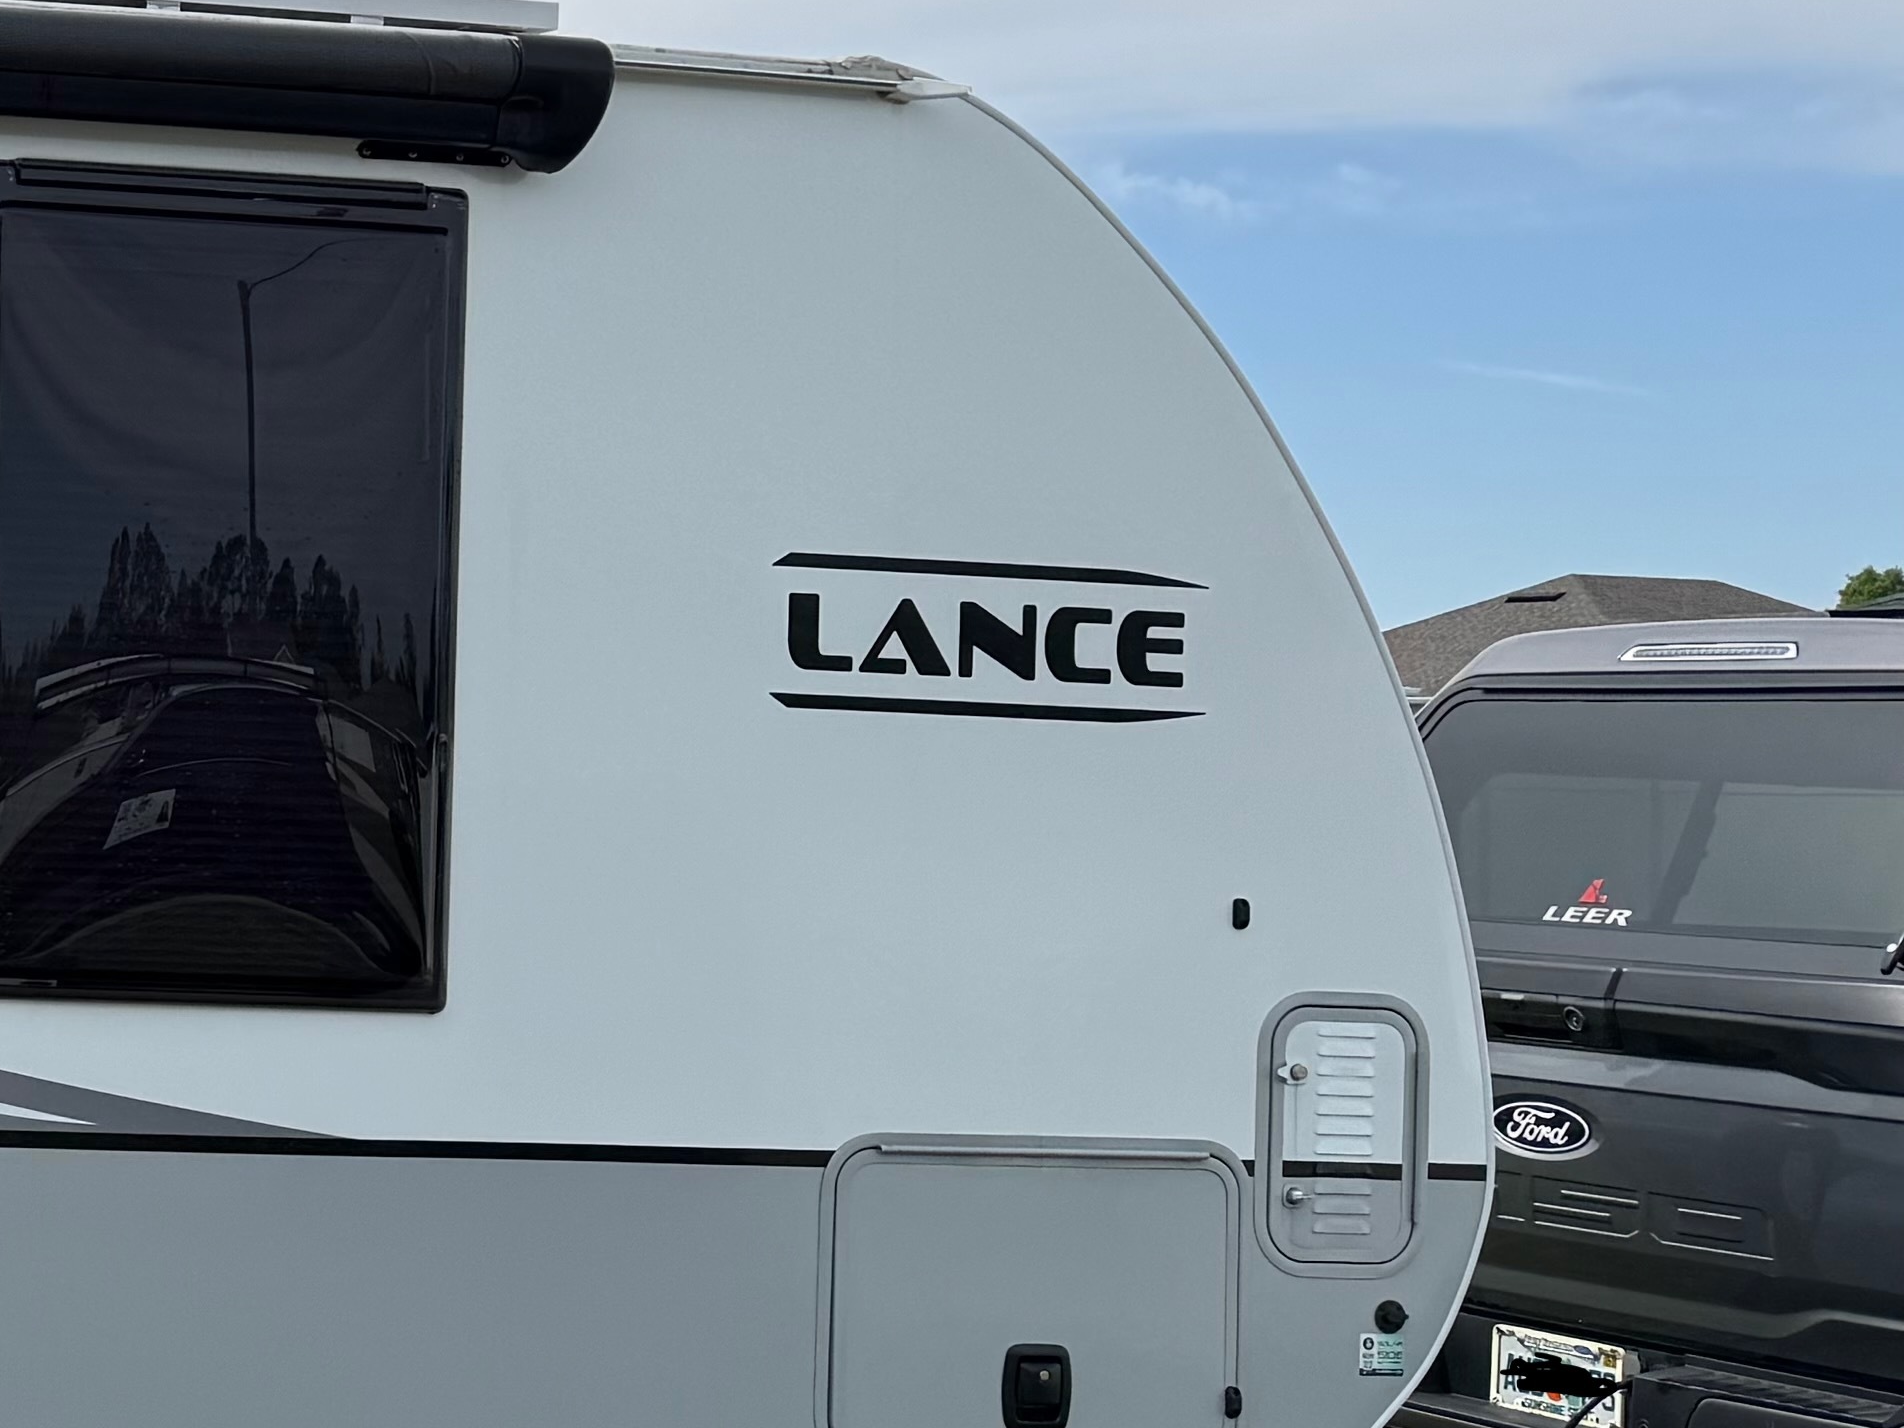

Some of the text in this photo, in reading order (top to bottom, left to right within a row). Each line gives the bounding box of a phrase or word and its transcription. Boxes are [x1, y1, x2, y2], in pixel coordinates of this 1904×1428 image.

[787, 592, 1185, 688] LANCE
[1542, 905, 1633, 927] LEER
[1506, 1106, 1571, 1145] Ford
